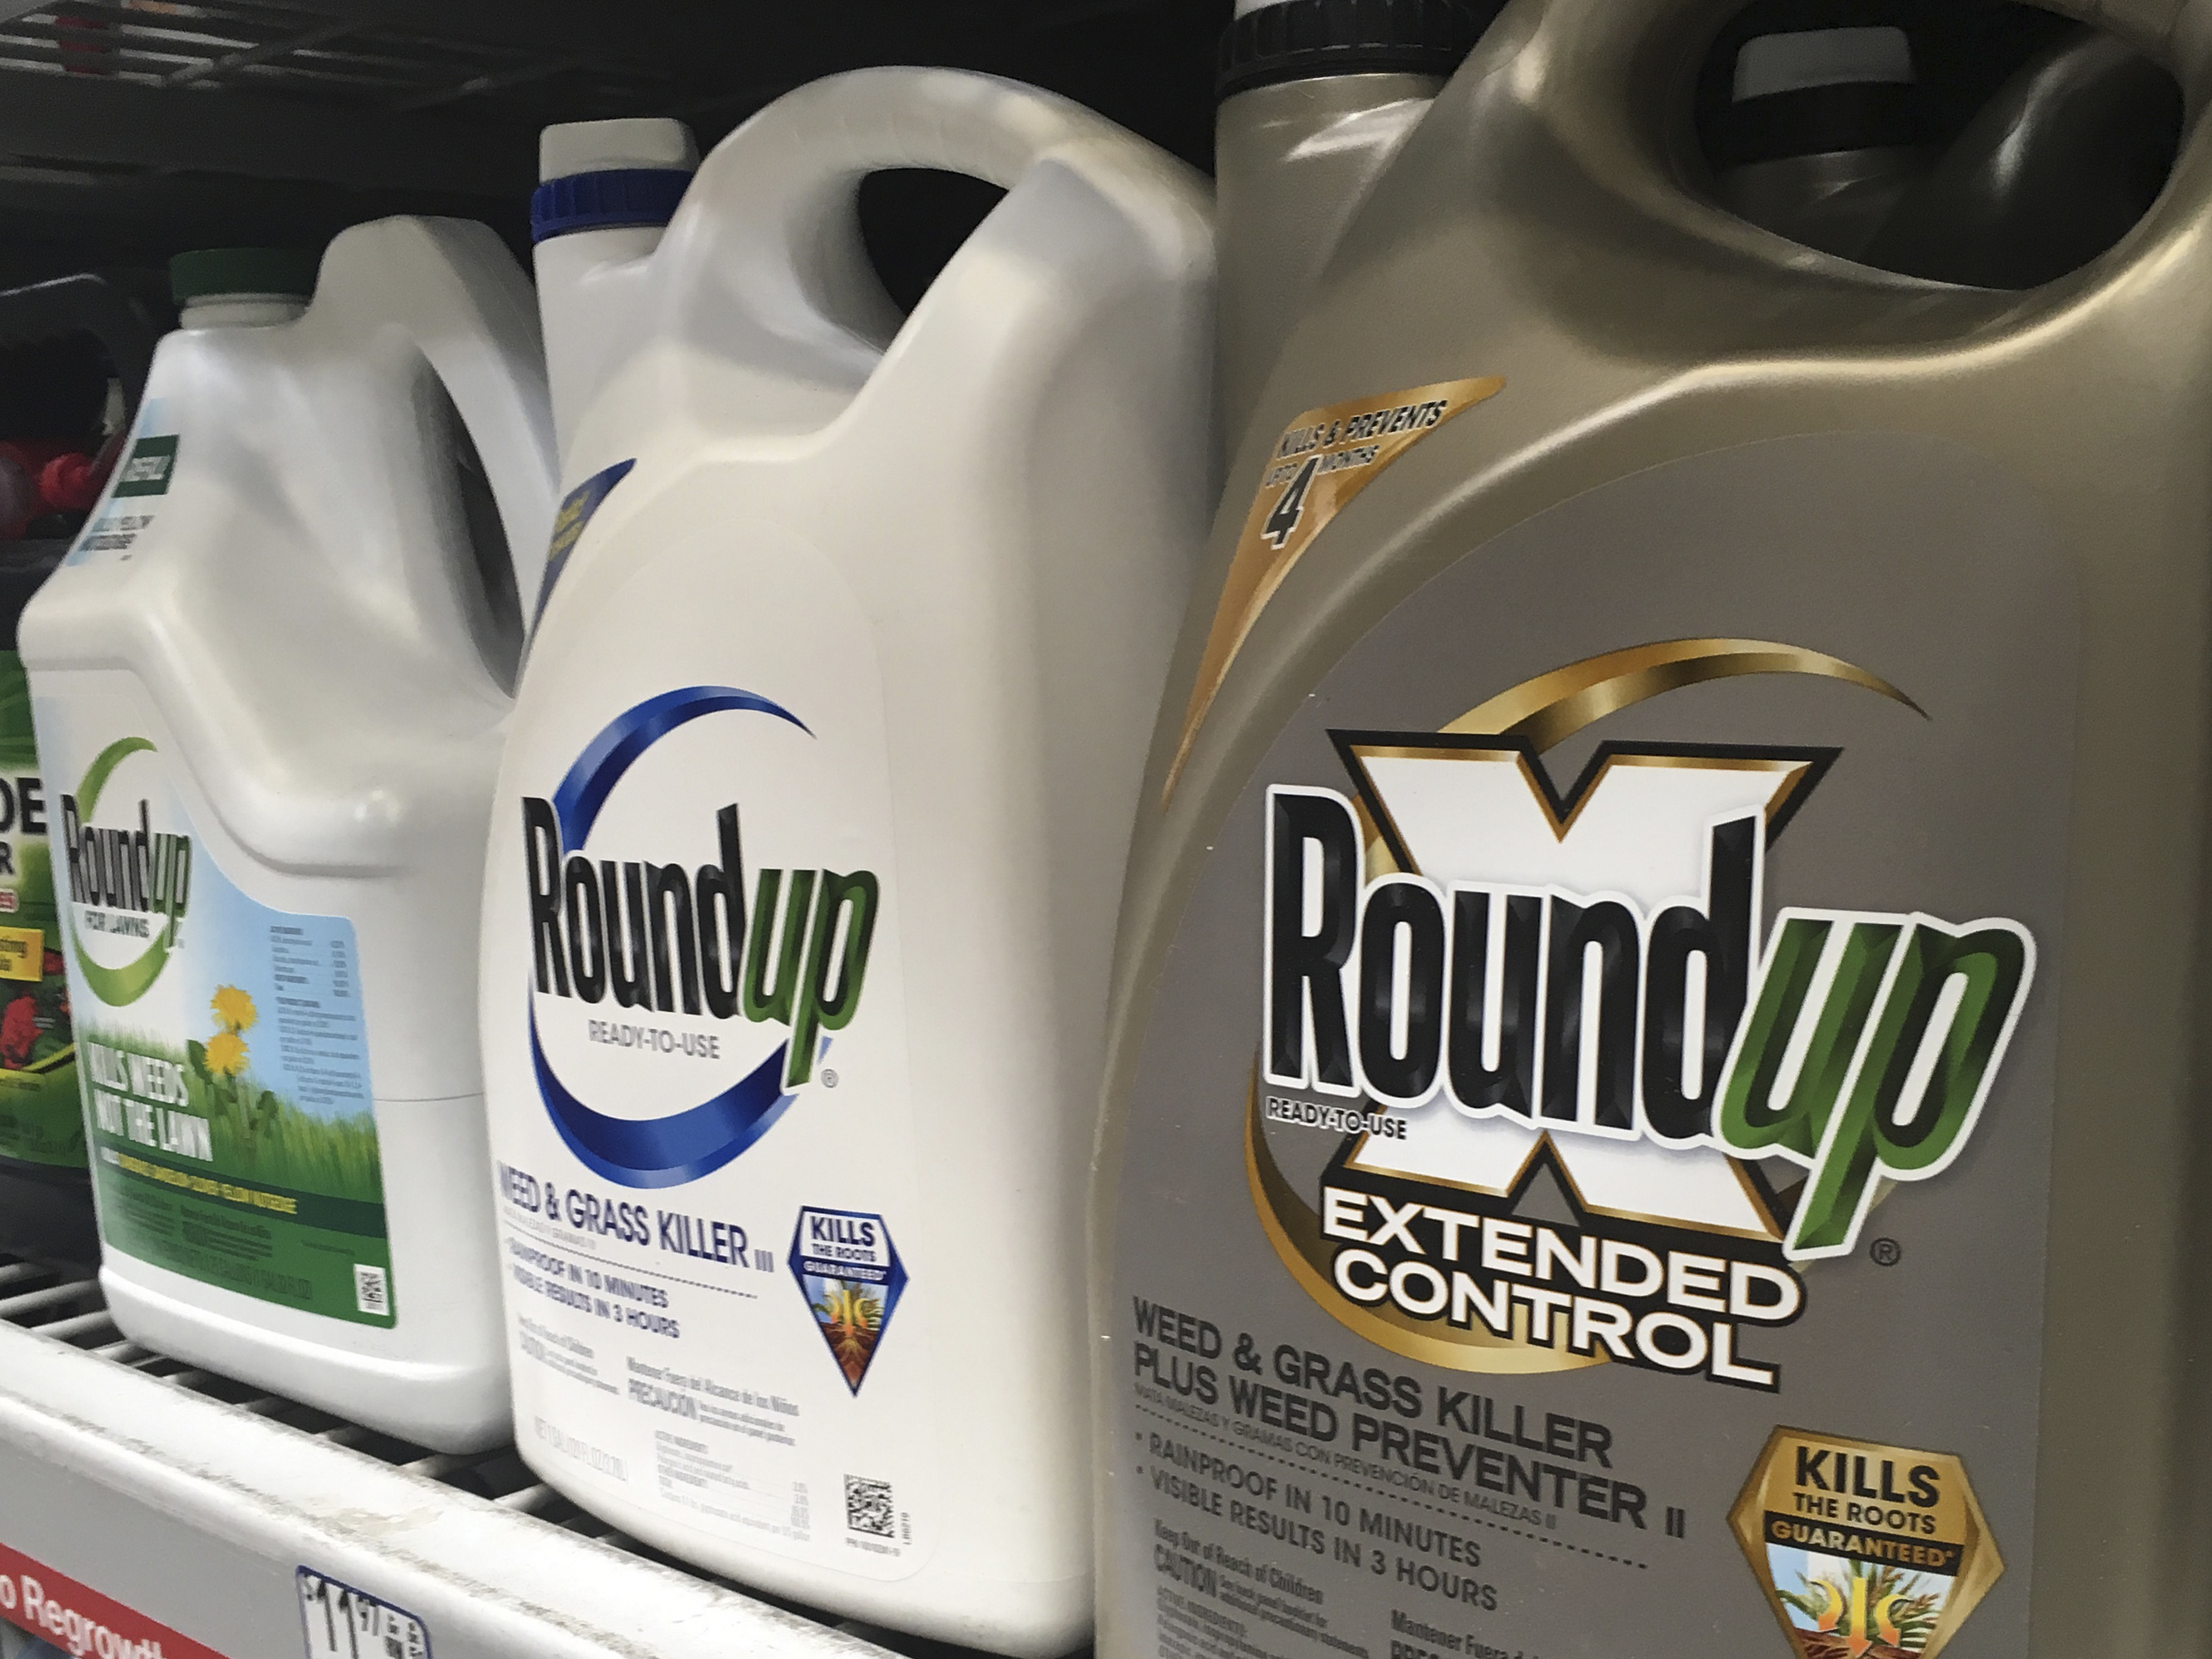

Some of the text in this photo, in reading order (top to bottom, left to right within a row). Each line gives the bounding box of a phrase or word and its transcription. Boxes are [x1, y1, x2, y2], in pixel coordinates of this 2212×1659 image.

[1339, 400, 1448, 445] PREVENTS
[1260, 454, 1323, 550] 4
[60, 794, 191, 947] Roundup
[521, 797, 880, 1087] Roundup
[589, 1019, 721, 1060] READY-TO-USE
[1266, 786, 2035, 1257] Roundup
[1266, 1095, 1408, 1140] READY-TO-USE
[544, 1181, 562, 1221] &
[565, 1189, 651, 1246] GRASS
[657, 1209, 750, 1268] KILLER
[810, 1215, 876, 1246] KILLS
[1322, 1186, 1801, 1320] EXTENDED
[604, 1274, 669, 1308] MINUTES
[613, 1304, 624, 1323] 3
[625, 1307, 680, 1339] HOURS
[1333, 1249, 1773, 1386] CONTROL
[1134, 1295, 1613, 1468] WEED & GRASS KILLER
[1133, 1340, 1686, 1538] PLUS WEED PREVENTER II
[1794, 1446, 1940, 1508] KILLS
[1149, 1432, 1480, 1567] RAINPROOF IN 10 MINUTES
[1295, 1442, 1330, 1464] CON
[1438, 1483, 1459, 1503] DE
[1464, 1491, 1542, 1525] MALEZAS
[1792, 1492, 1936, 1535] THE ROOTS
[1150, 1465, 1498, 1612] VISIBLE RESULTS IN 3 HOURS
[1269, 1567, 1324, 1604] Children
[1390, 1609, 1463, 1652] Mantener
